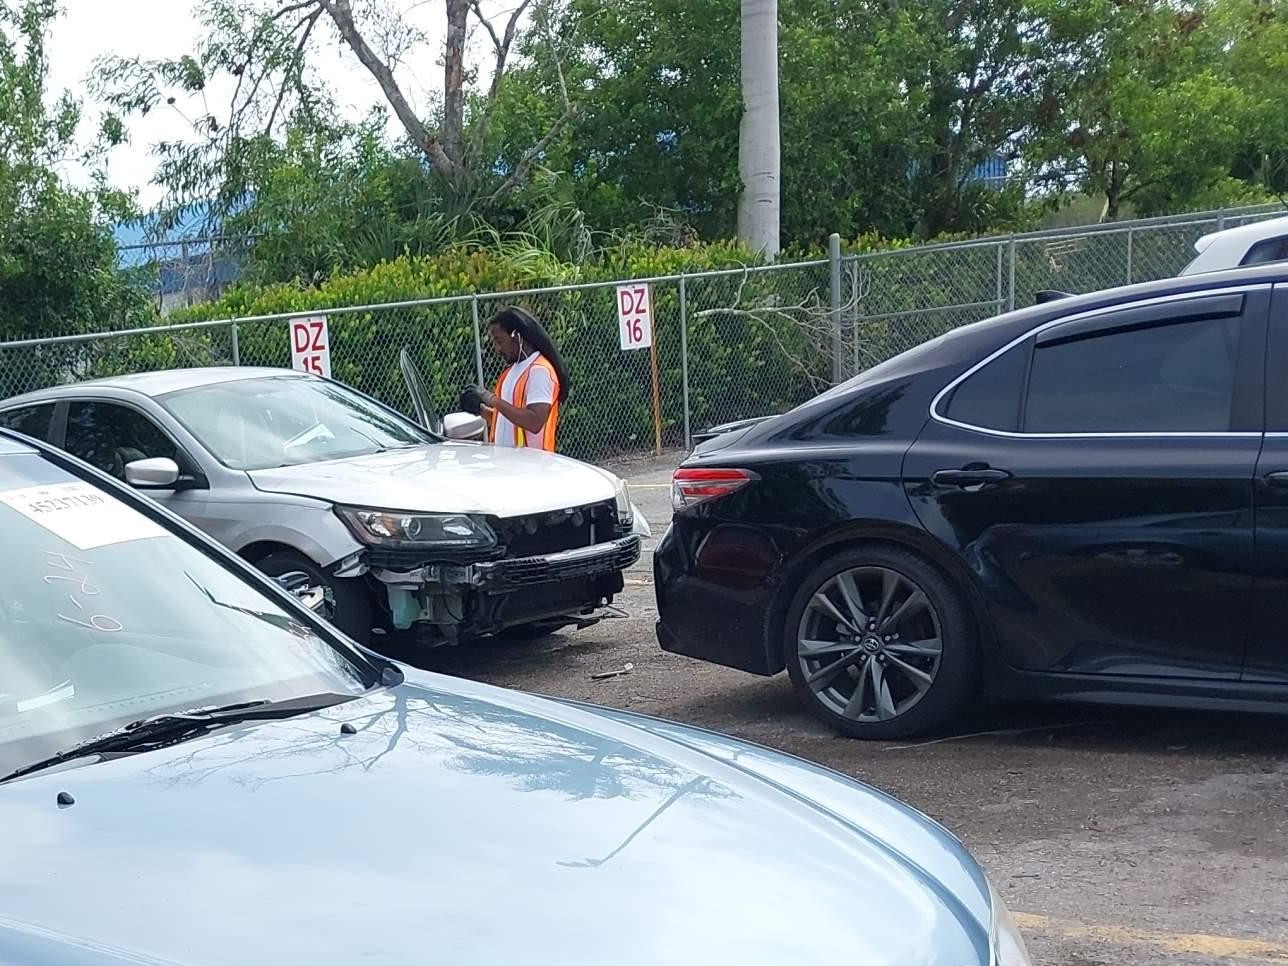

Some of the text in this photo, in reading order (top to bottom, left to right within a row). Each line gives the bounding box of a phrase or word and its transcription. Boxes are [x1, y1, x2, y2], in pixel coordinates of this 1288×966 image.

[620, 288, 647, 316] DZ
[293, 322, 325, 353] DZ
[625, 318, 643, 344] 16
[302, 355, 323, 376] 15
